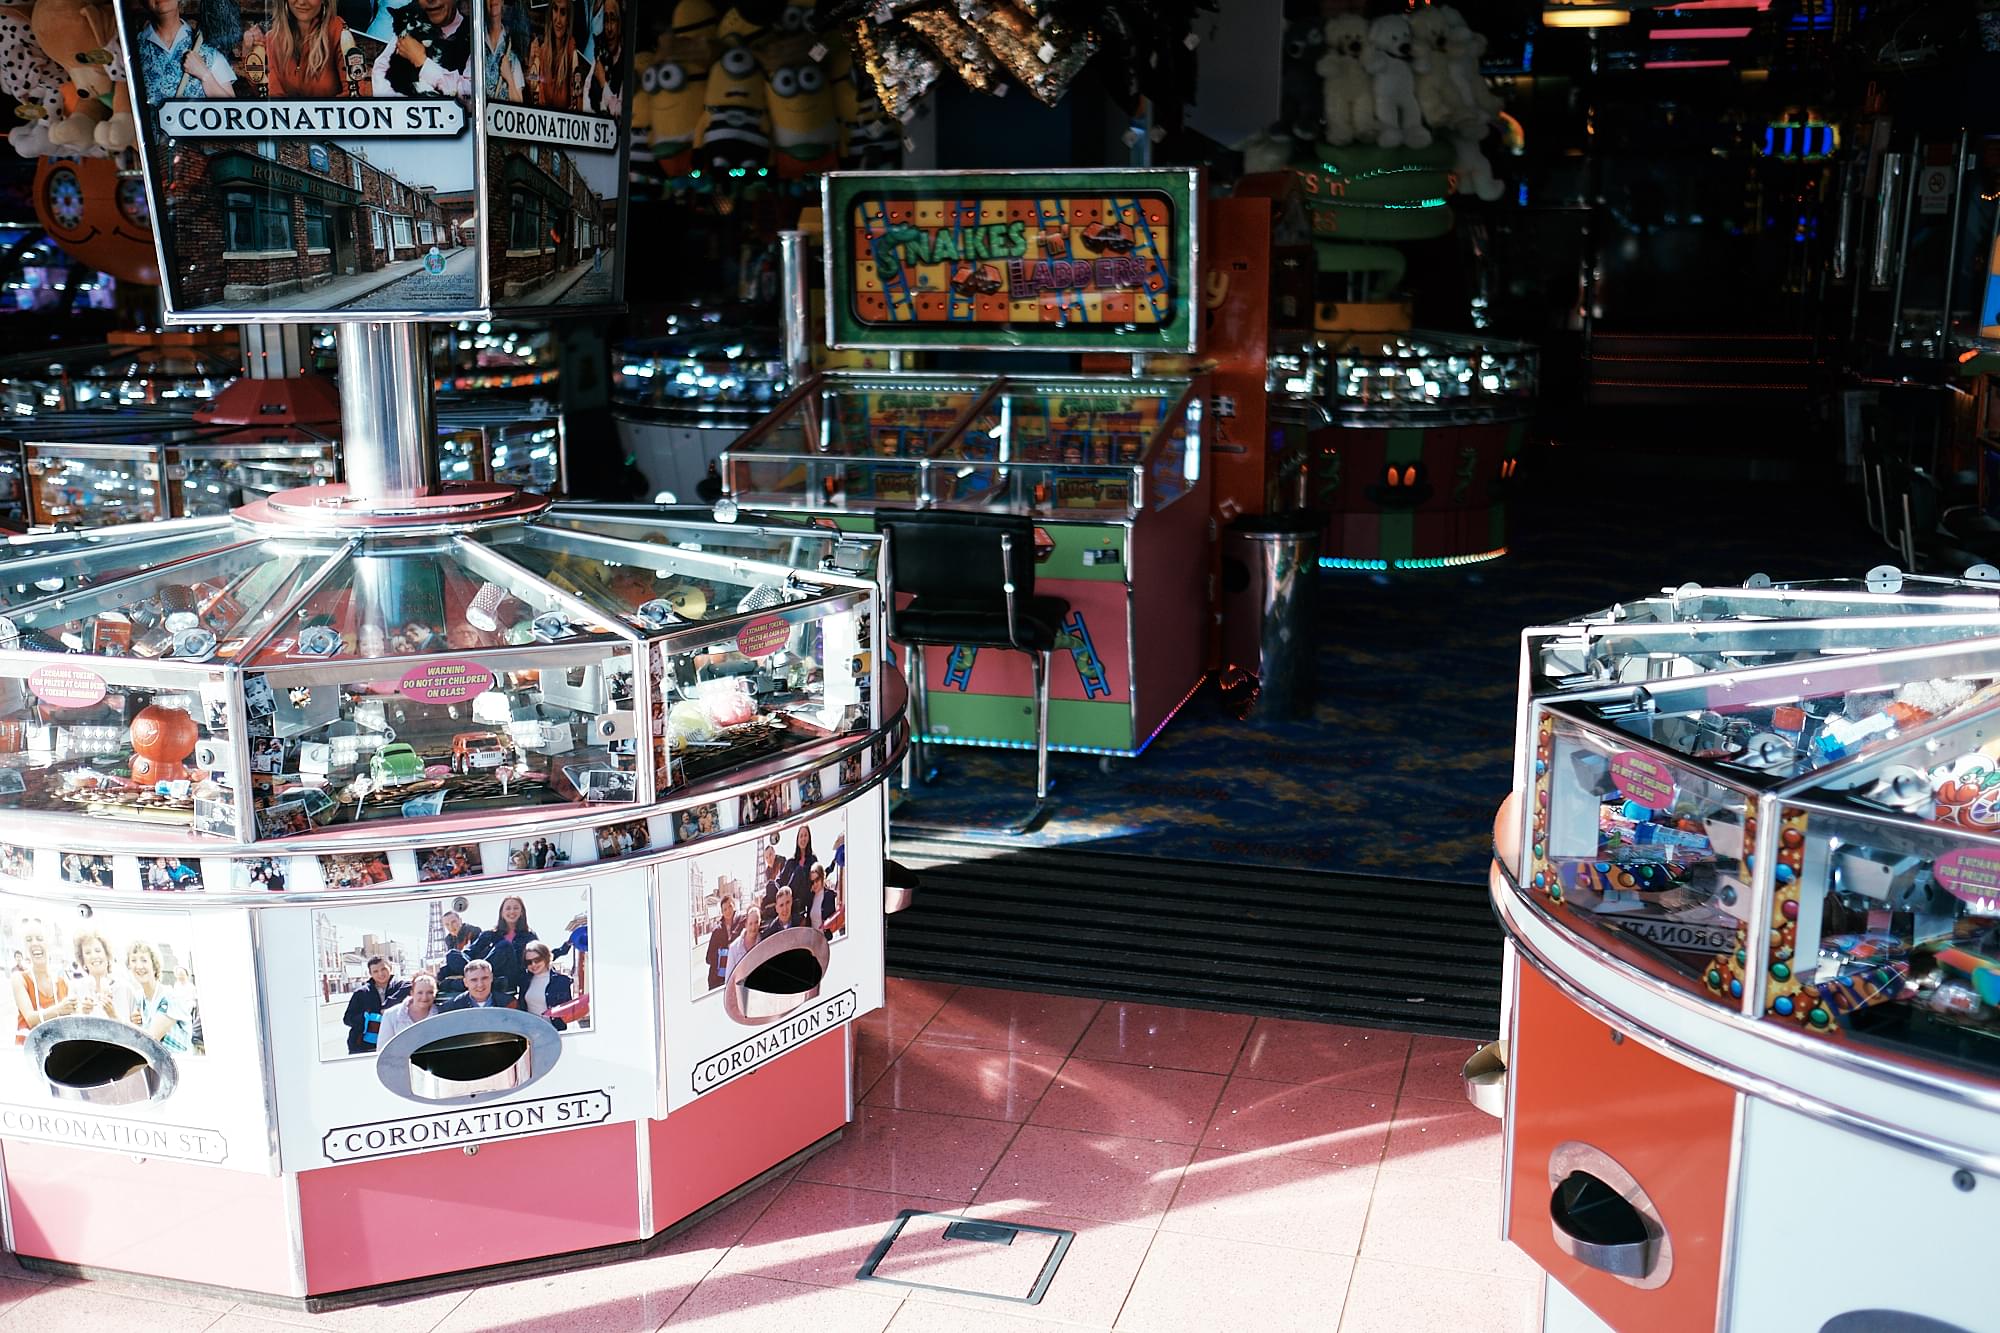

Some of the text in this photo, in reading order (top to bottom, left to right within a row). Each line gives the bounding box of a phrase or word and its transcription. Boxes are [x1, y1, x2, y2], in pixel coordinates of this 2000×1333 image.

[178, 106, 444, 130] CORONATION ST.
[493, 109, 609, 144] CORONATION ST.
[253, 163, 304, 188] ROVERS
[875, 220, 1027, 280] SNAKES
[1007, 256, 1146, 300] LADDERS
[403, 674, 488, 689] DO NOT SIT CHILDREN
[427, 665, 466, 676] WARNING
[427, 687, 466, 698] ON GLASS
[1620, 767, 1633, 779] NOT
[1632, 772, 1643, 783] SIT
[1643, 776, 1671, 796] CHILDREN
[1940, 864, 1959, 877] FOR
[705, 1000, 845, 1082] CORONATION ST.
[3, 1111, 209, 1155] CORONATION ST.
[345, 1099, 591, 1152] CORONATION ST.
